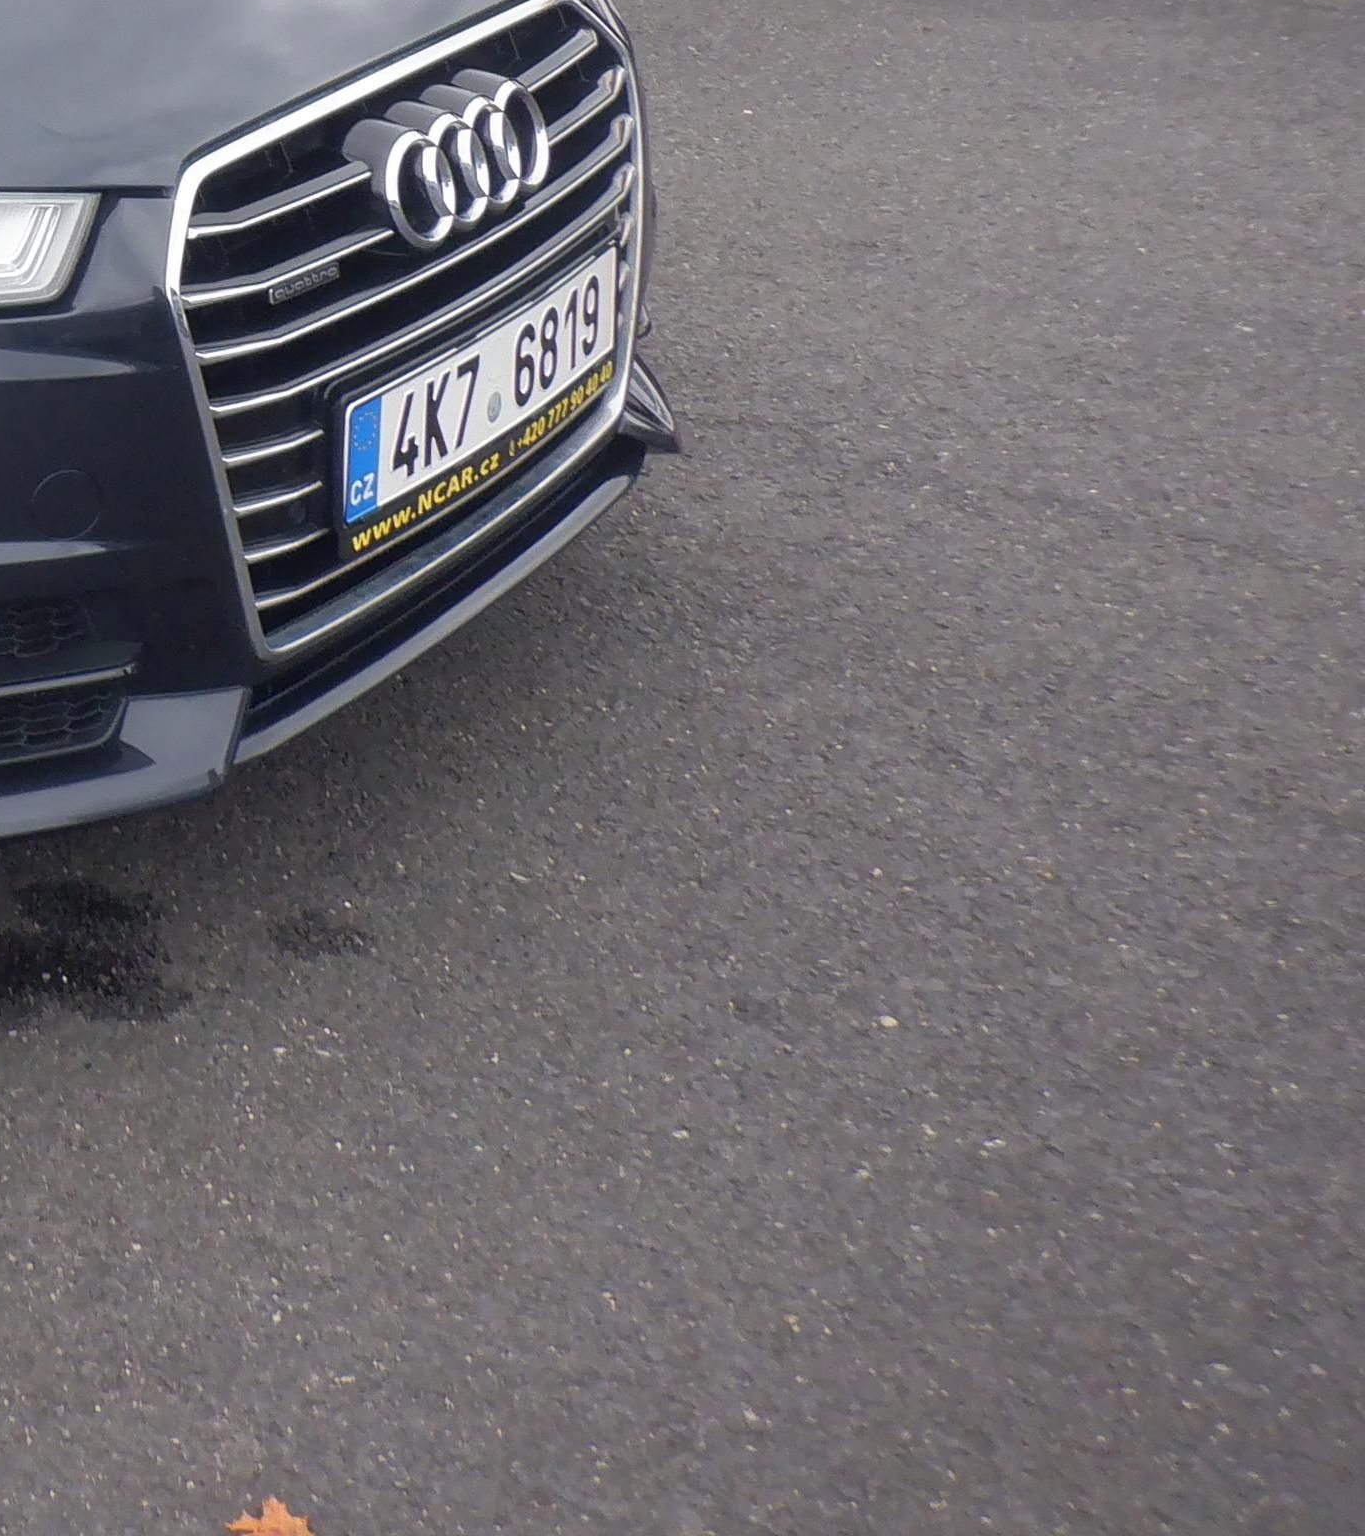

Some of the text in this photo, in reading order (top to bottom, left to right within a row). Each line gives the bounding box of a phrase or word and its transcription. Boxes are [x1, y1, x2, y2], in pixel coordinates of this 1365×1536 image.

[273, 265, 339, 300] quattro
[389, 274, 600, 478] 4K7 6819
[349, 471, 375, 506] CZ
[351, 451, 501, 552] www.NCAR.cz
[547, 397, 569, 429] 777
